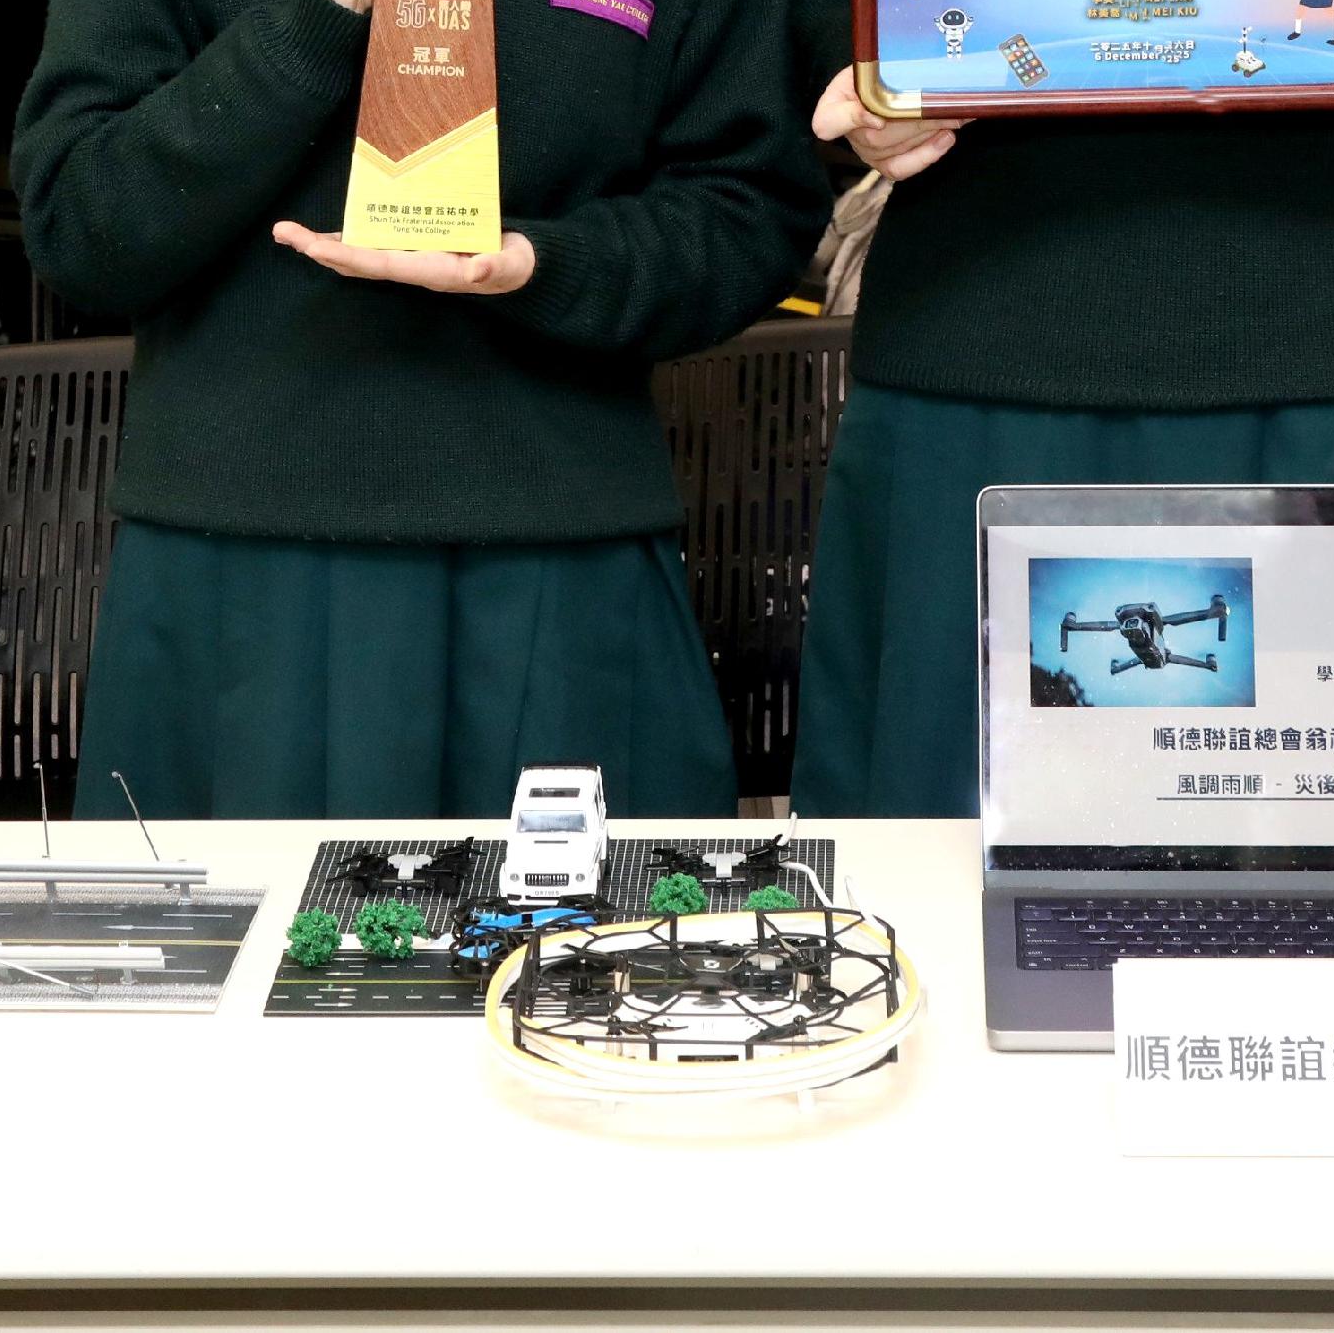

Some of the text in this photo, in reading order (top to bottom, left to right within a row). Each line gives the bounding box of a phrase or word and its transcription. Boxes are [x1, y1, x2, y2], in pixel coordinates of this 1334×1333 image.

[1177, 6, 1198, 16] KIU
[412, 46, 451, 63] 冠軍
[1094, 52, 1102, 61] 6
[1104, 51, 1159, 61] December
[397, 64, 465, 77] CHAMPION
[1177, 774, 1264, 795] 風調雨順
